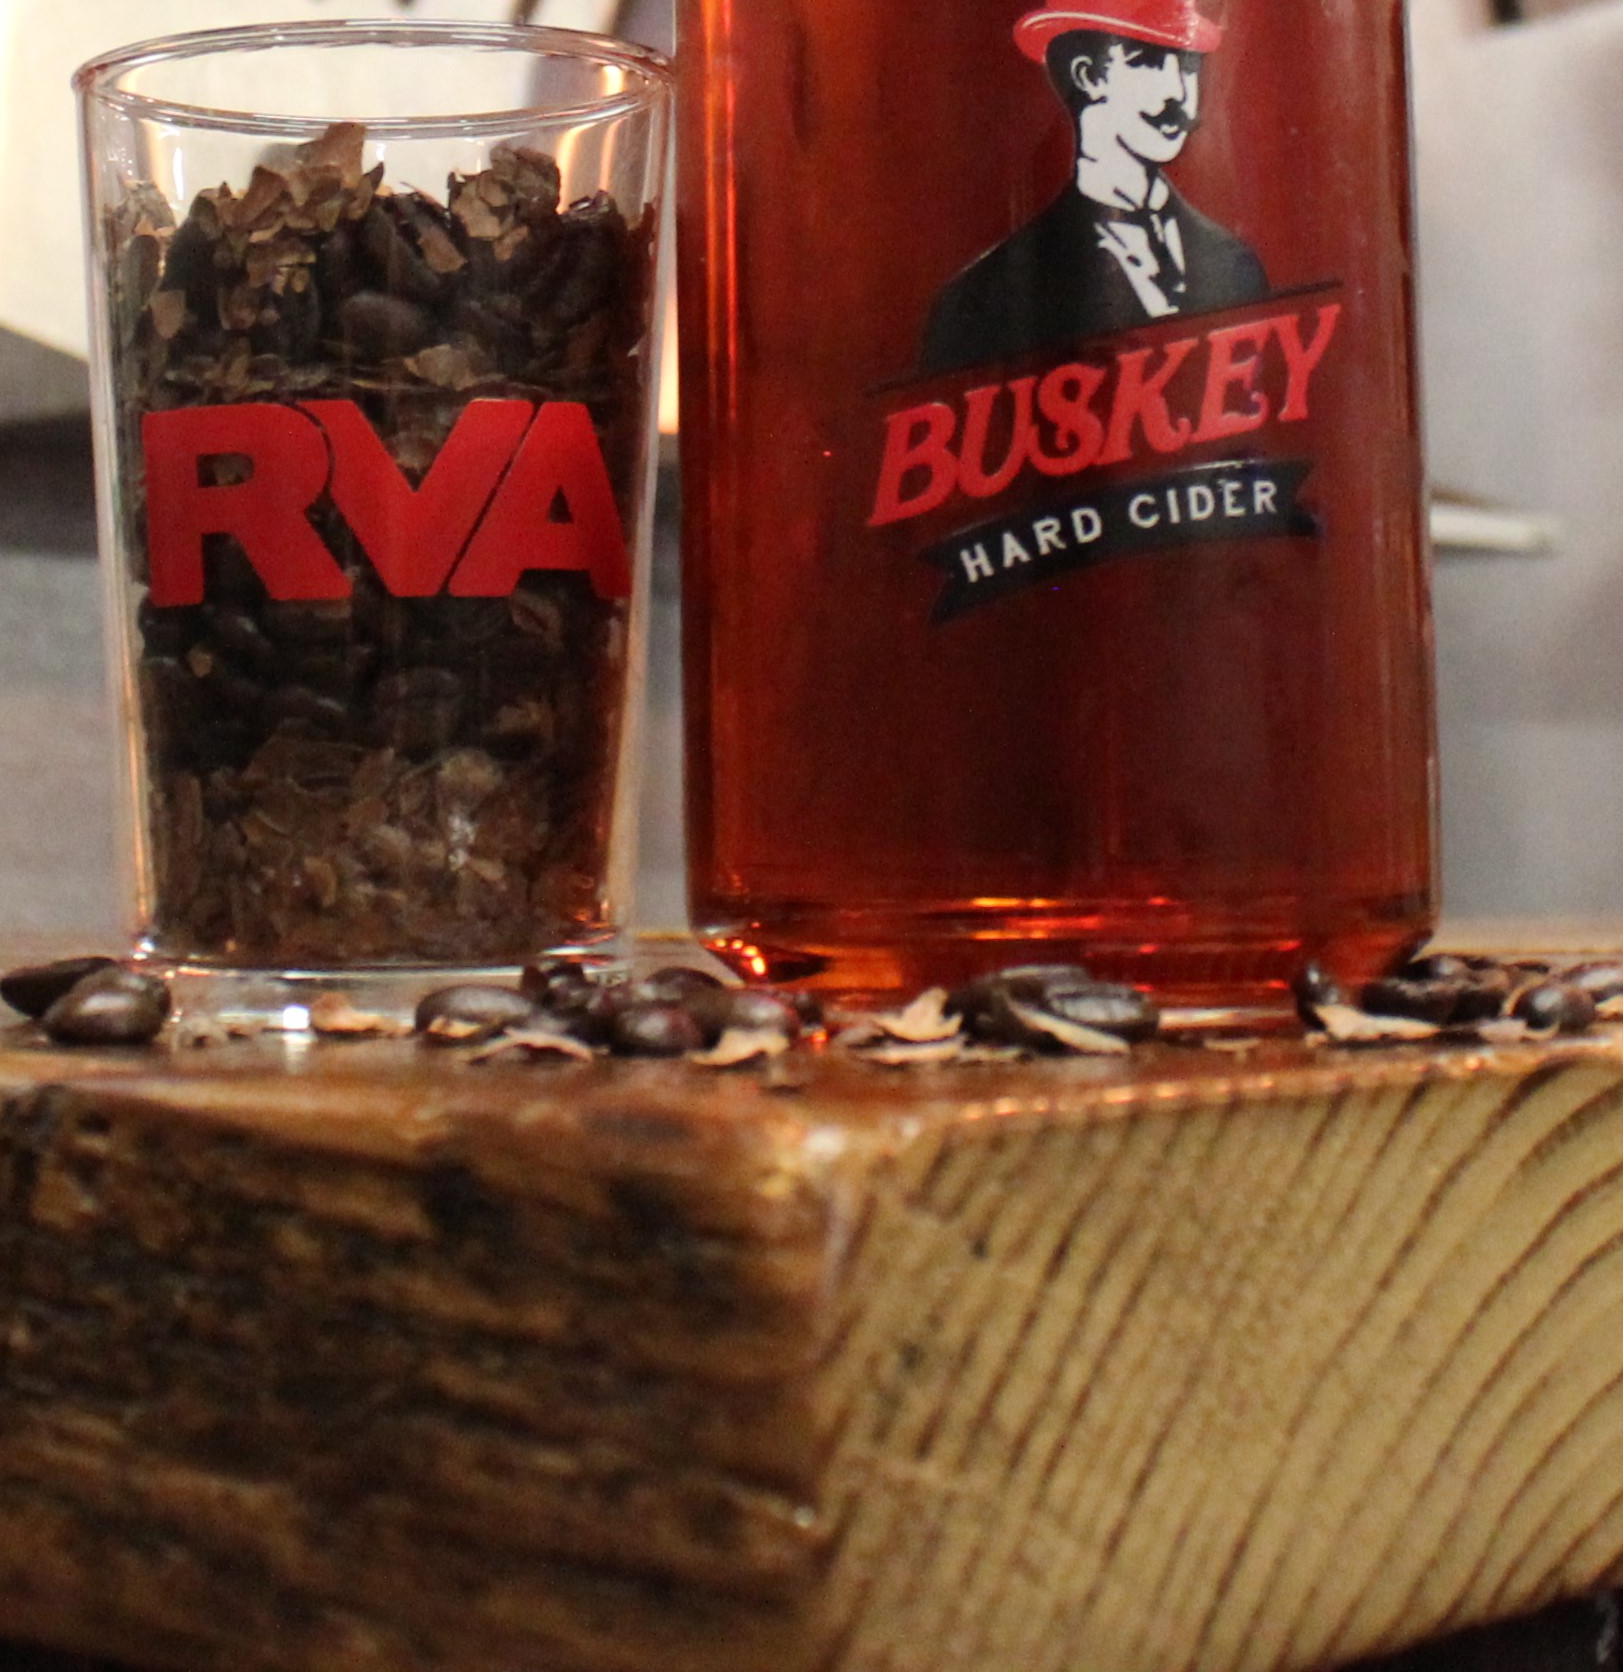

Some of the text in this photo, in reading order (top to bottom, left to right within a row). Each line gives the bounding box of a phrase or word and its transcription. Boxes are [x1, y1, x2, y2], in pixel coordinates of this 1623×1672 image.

[142, 399, 633, 607] RVA
[868, 304, 1342, 527] BUSKEY
[959, 478, 1279, 584] HARD CIDER
